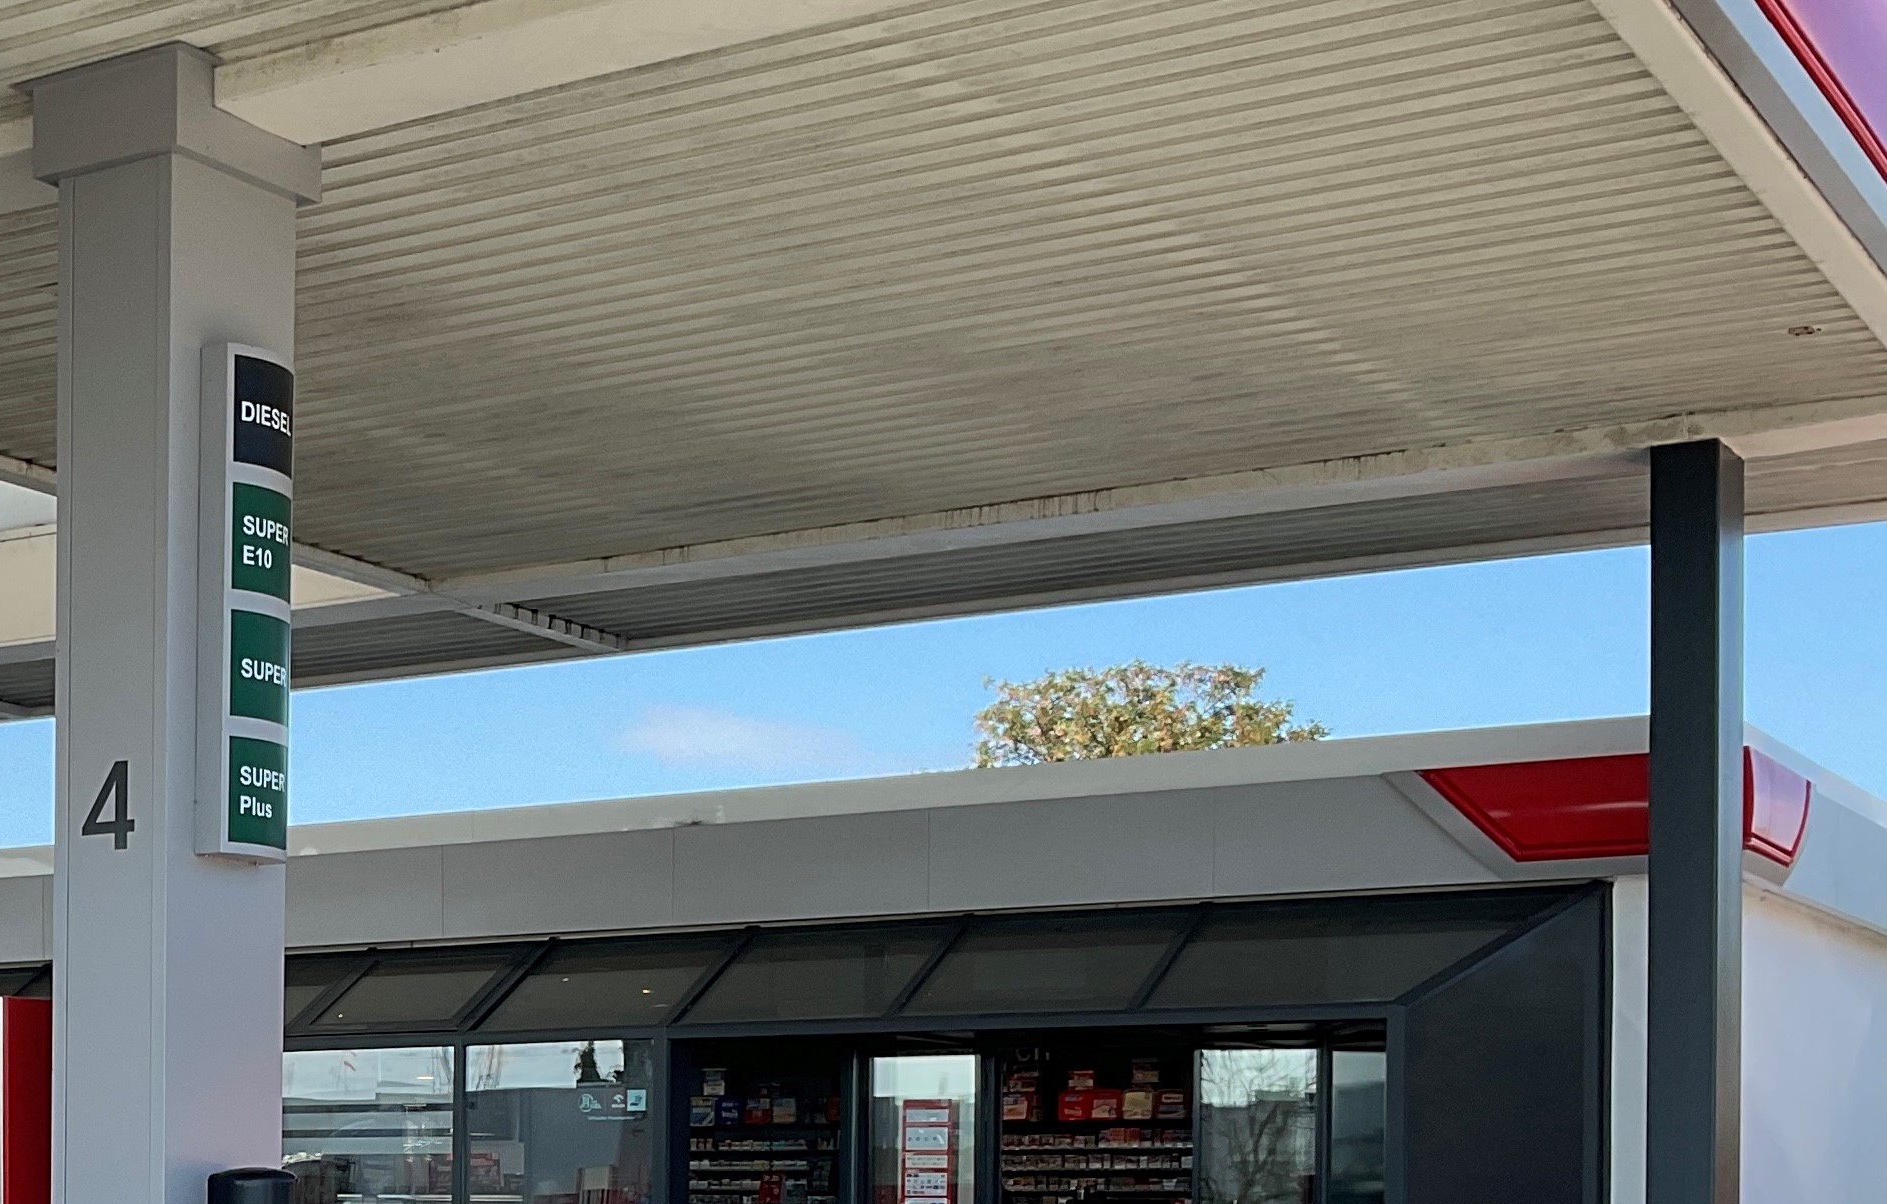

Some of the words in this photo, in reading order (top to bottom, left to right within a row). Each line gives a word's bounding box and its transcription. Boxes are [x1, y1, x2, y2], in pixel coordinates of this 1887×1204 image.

[241, 401, 291, 436] DIESEL
[242, 515, 289, 546] SUPER
[243, 545, 272, 569] E10
[240, 658, 287, 687] SUPER
[239, 766, 285, 792] SUPER
[82, 760, 135, 850] 4
[239, 795, 273, 818] Plus
